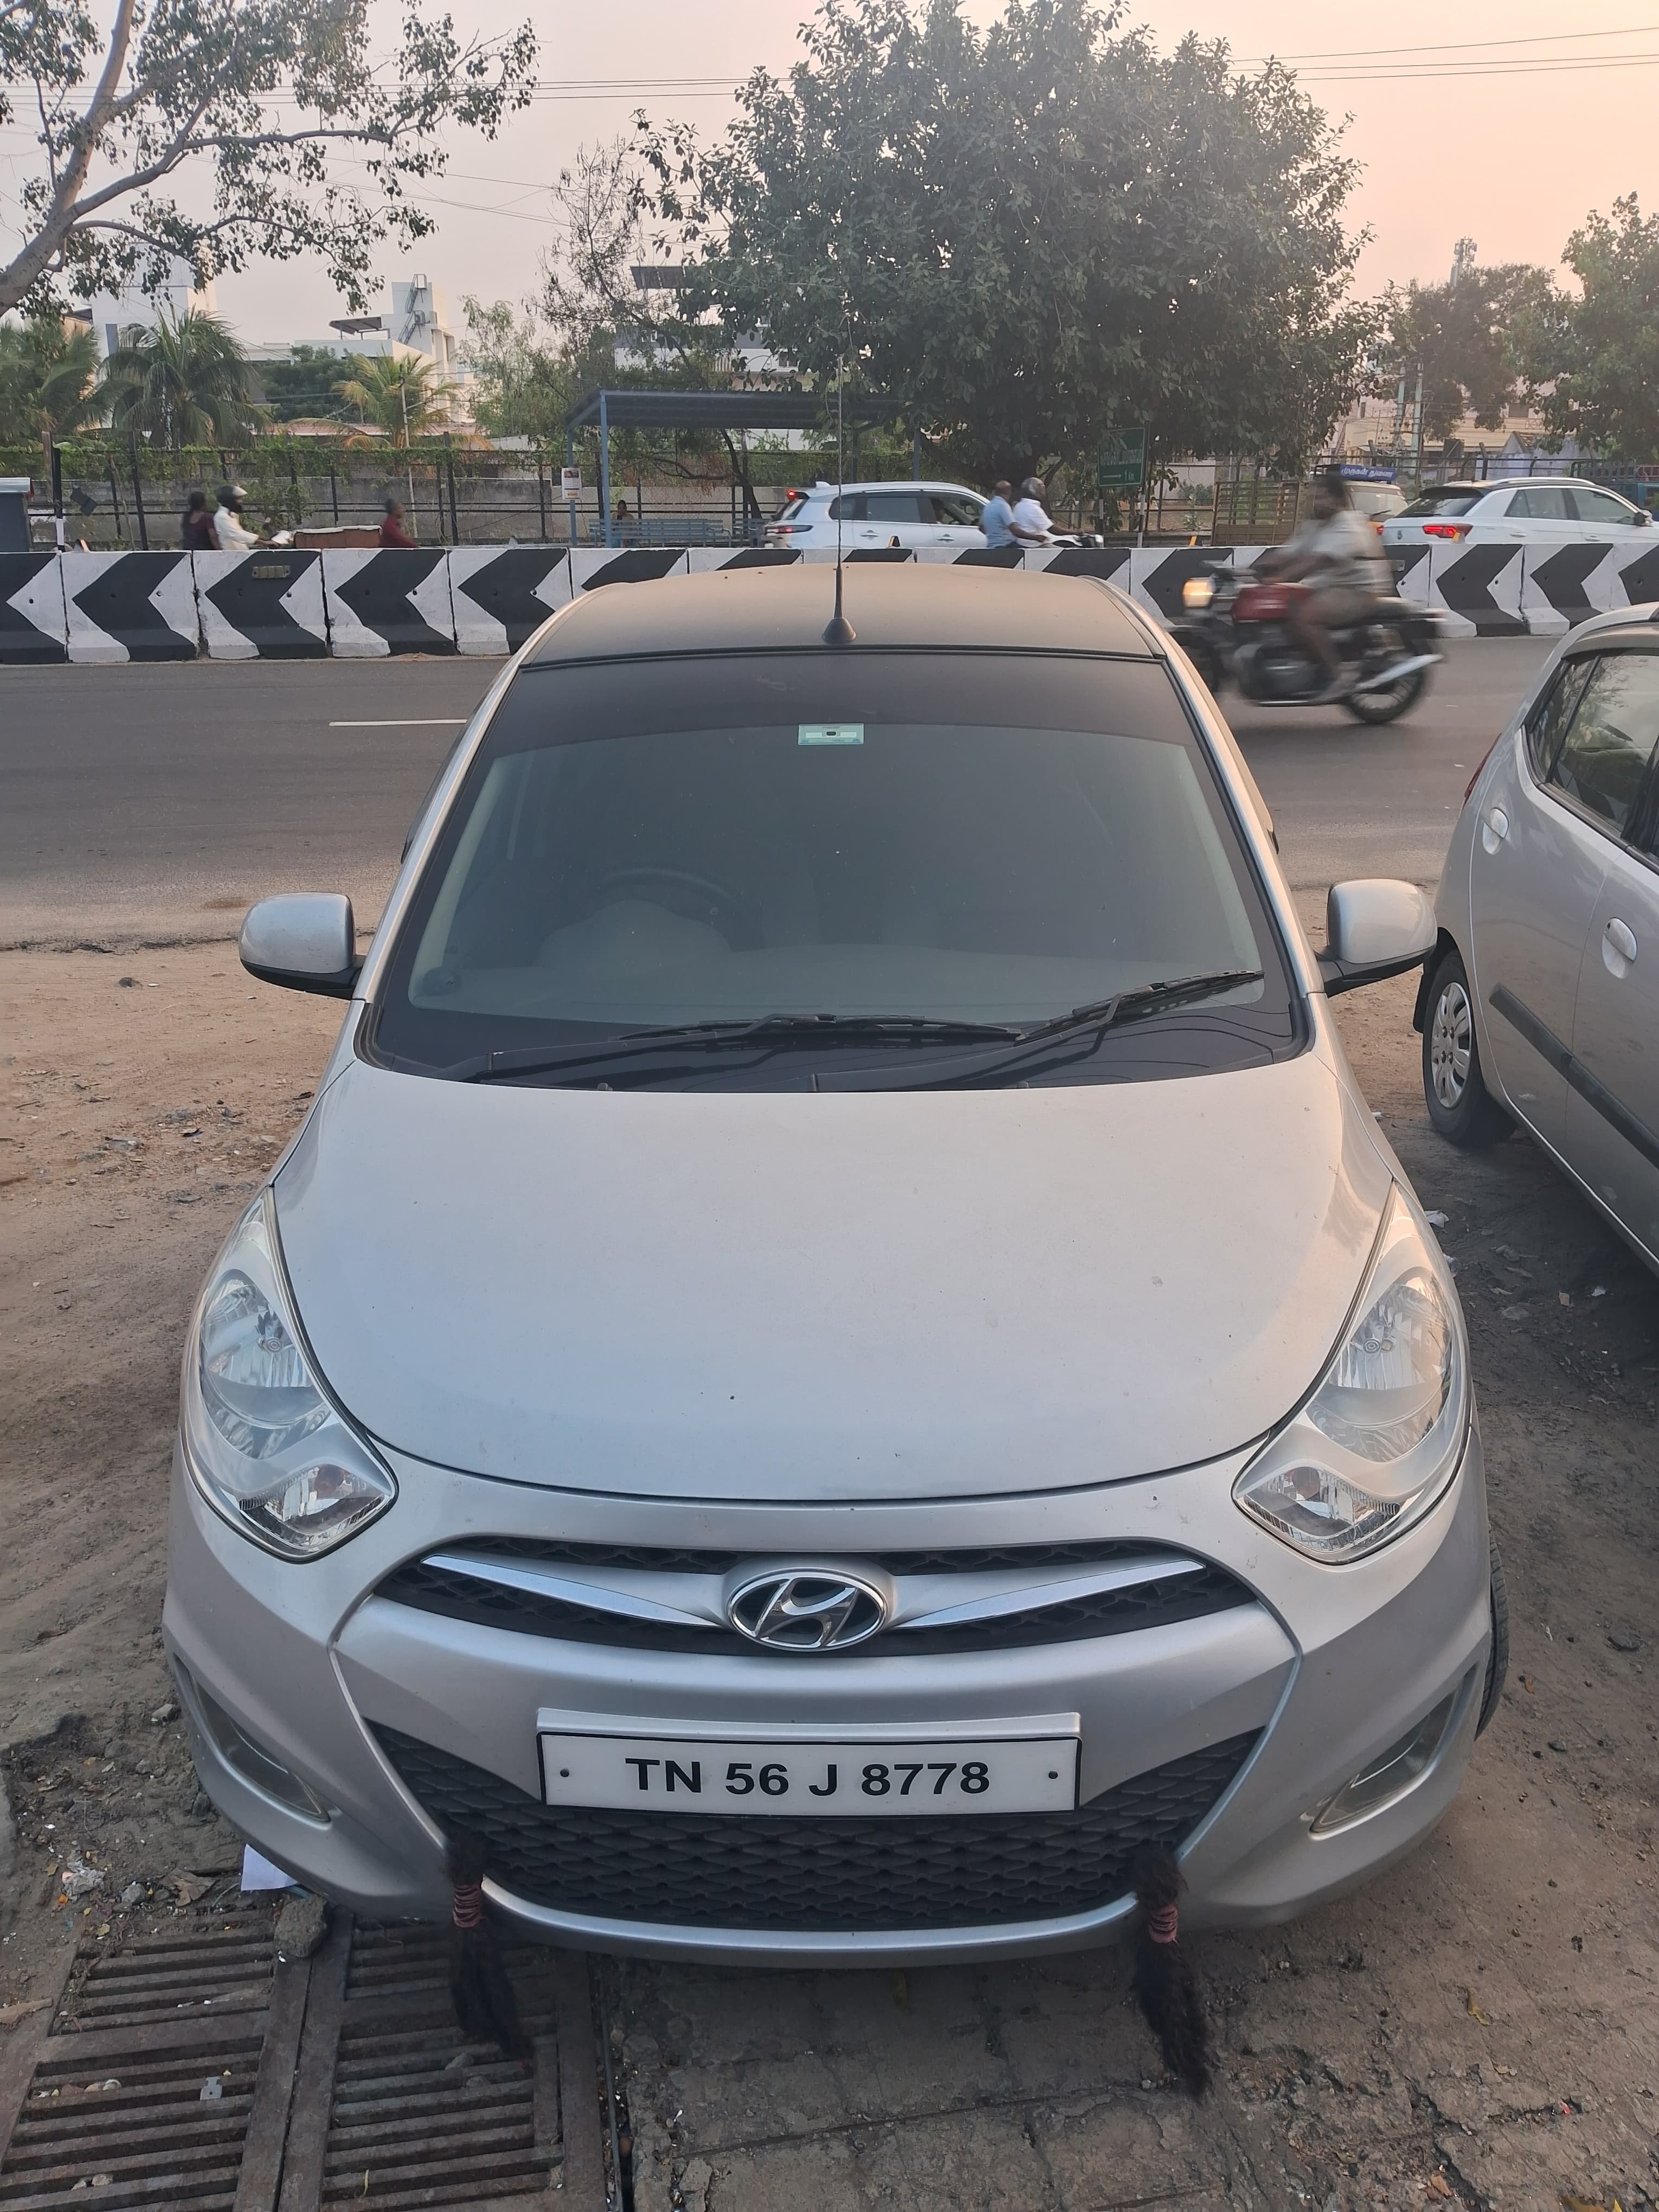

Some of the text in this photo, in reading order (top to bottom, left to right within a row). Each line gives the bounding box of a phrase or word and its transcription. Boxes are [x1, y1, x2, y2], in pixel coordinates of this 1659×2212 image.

[625, 1758, 989, 1796] TN 56 J 8778
